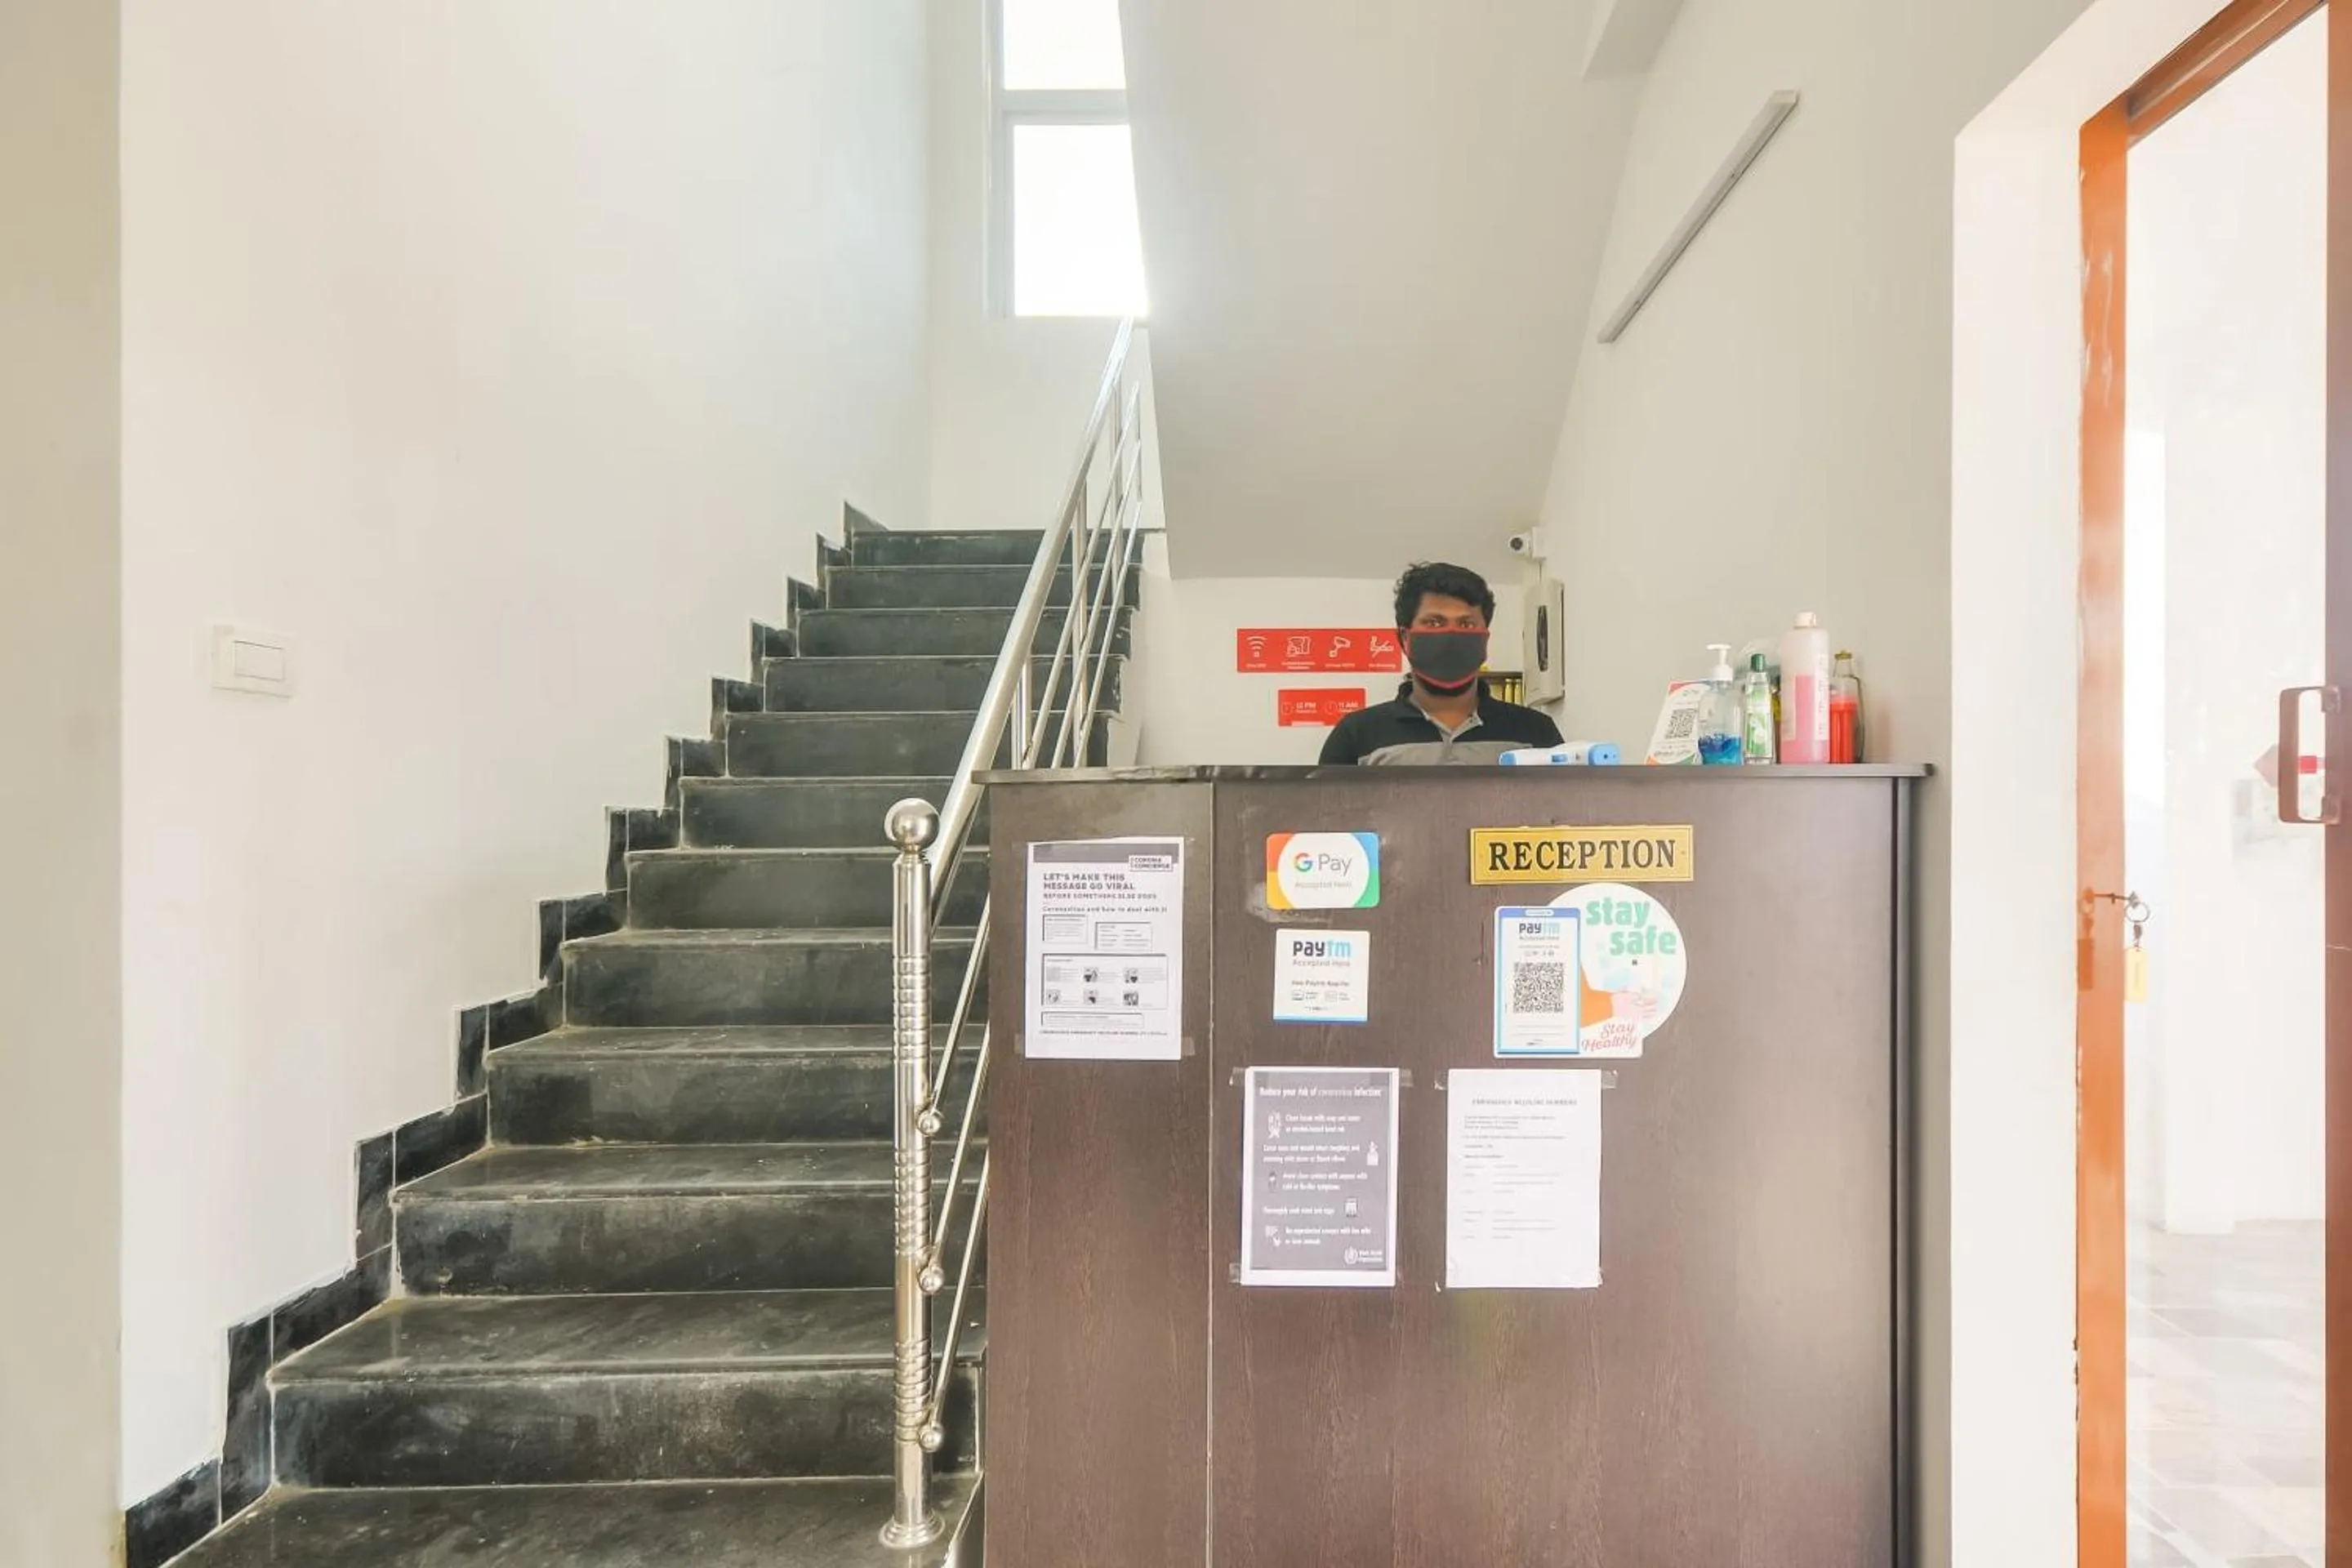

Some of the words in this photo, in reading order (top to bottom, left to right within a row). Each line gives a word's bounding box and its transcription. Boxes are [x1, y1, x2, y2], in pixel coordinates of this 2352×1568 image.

[1294, 852, 1313, 872] G
[1317, 853, 1352, 877] Pay
[1489, 840, 1676, 871] RECEPTION
[1043, 882, 1087, 890] MESSAGE
[1089, 882, 1102, 890] GO
[1106, 882, 1135, 890] VIRAL
[1586, 897, 1650, 929] stay
[1610, 925, 1677, 956] safe
